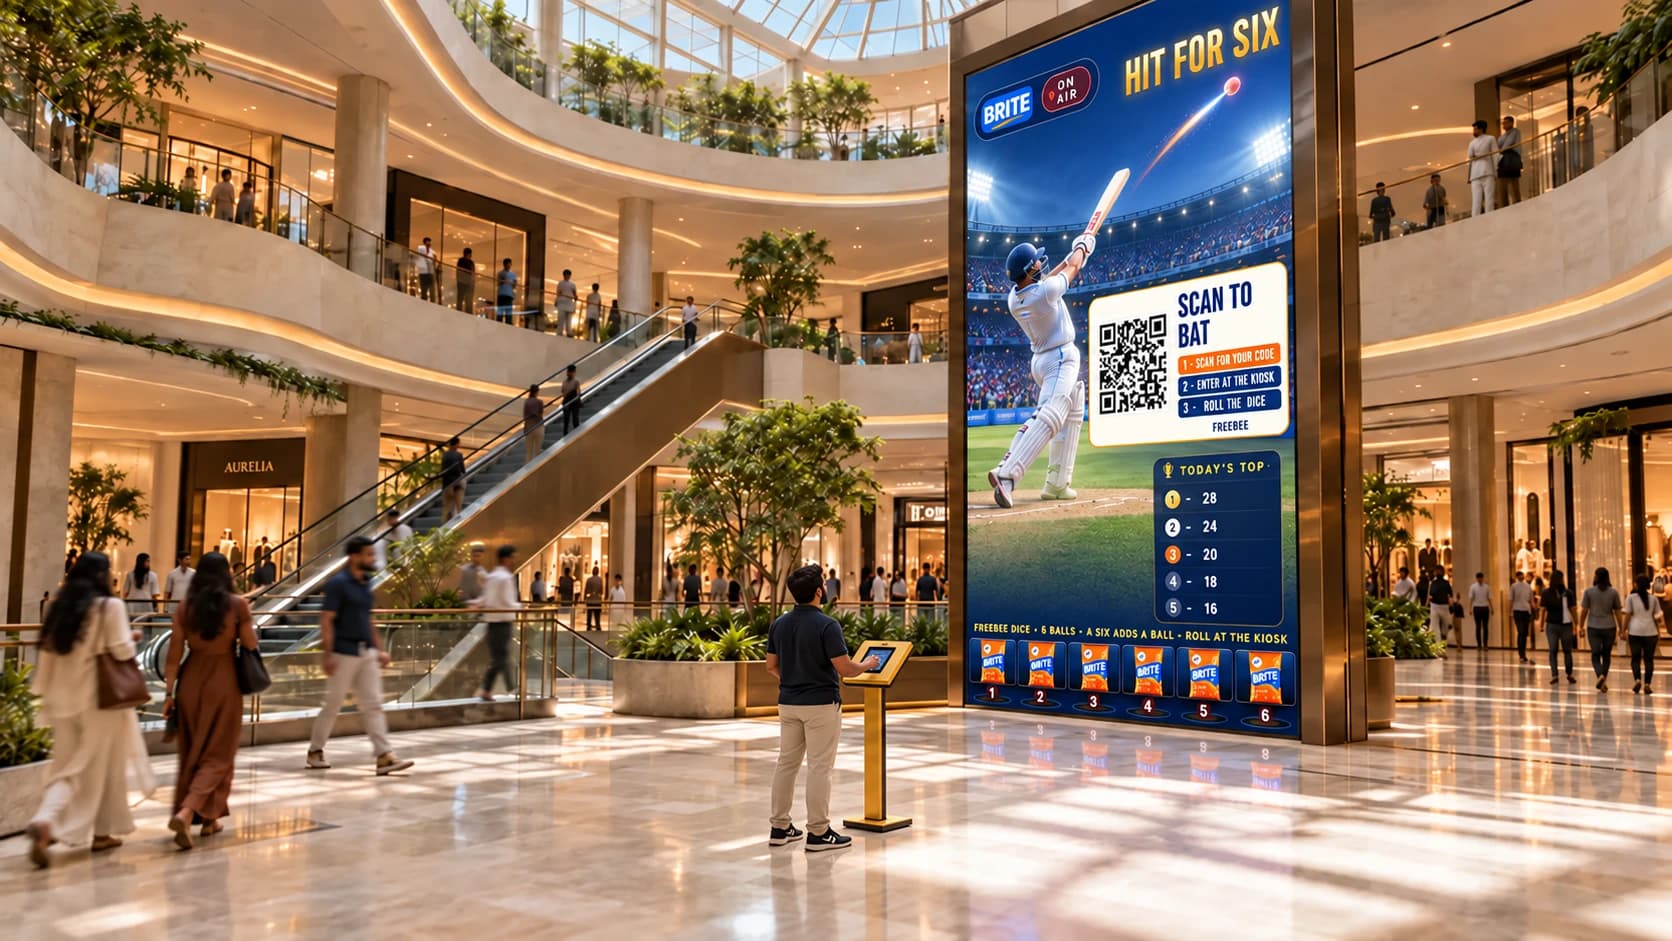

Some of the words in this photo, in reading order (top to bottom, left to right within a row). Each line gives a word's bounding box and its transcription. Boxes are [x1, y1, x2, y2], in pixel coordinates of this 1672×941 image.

[1125, 47, 1166, 96] HIT
[1174, 28, 1224, 79] FOR
[1233, 6, 1280, 58] SIX
[1057, 75, 1074, 90] ON
[1057, 88, 1077, 104] AIR
[984, 92, 1030, 125] BRITE
[1178, 286, 1223, 318] SCAN
[1229, 281, 1252, 309] TO
[1178, 319, 1210, 348] BAT
[1183, 359, 1187, 371] 1
[1195, 356, 1214, 369] SCAN
[1216, 353, 1231, 366] FOR
[1232, 349, 1253, 363] YOUR
[1254, 347, 1275, 360] CODE
[1182, 380, 1188, 392] 2
[1196, 377, 1220, 390] ENTER
[1222, 375, 1232, 388] AT
[1233, 373, 1249, 386] THE
[1250, 370, 1275, 384] KIOSK
[1183, 402, 1189, 414] 3
[1203, 398, 1224, 412] ROLL
[1226, 396, 1242, 409] THE
[1246, 394, 1266, 407] DICE
[1212, 420, 1249, 432] FREEBEE
[224, 460, 274, 473] AURELIA
[1180, 463, 1234, 476] TODAY'S
[1240, 461, 1265, 473] TOP
[1170, 495, 1175, 505] 1
[1202, 491, 1217, 505] 28
[1169, 522, 1176, 533] 2
[1202, 519, 1217, 533] 24
[1169, 548, 1177, 561] 3
[1203, 547, 1217, 561] 20
[1169, 575, 1177, 588] 4
[1204, 575, 1217, 588] 18
[1170, 601, 1177, 614] 5
[1204, 602, 1217, 616] 16
[974, 623, 1008, 633] FREEBEE
[1011, 624, 1030, 634] DICE
[1049, 625, 1076, 636] BALLS
[1086, 627, 1093, 636] A
[1095, 628, 1110, 637] SIX
[1113, 628, 1137, 638] ADDS
[1140, 630, 1148, 639] A
[1150, 630, 1174, 640] BALL
[1185, 631, 1210, 641] ROLL
[1213, 631, 1227, 641] AT
[1229, 632, 1250, 643] THE
[1253, 633, 1288, 644] KIOSK
[988, 687, 995, 699] 1
[1036, 691, 1044, 703] 2
[1089, 696, 1097, 708] 3
[1143, 700, 1152, 712] 4
[1199, 705, 1208, 717] 5
[1261, 709, 1270, 722] 6
